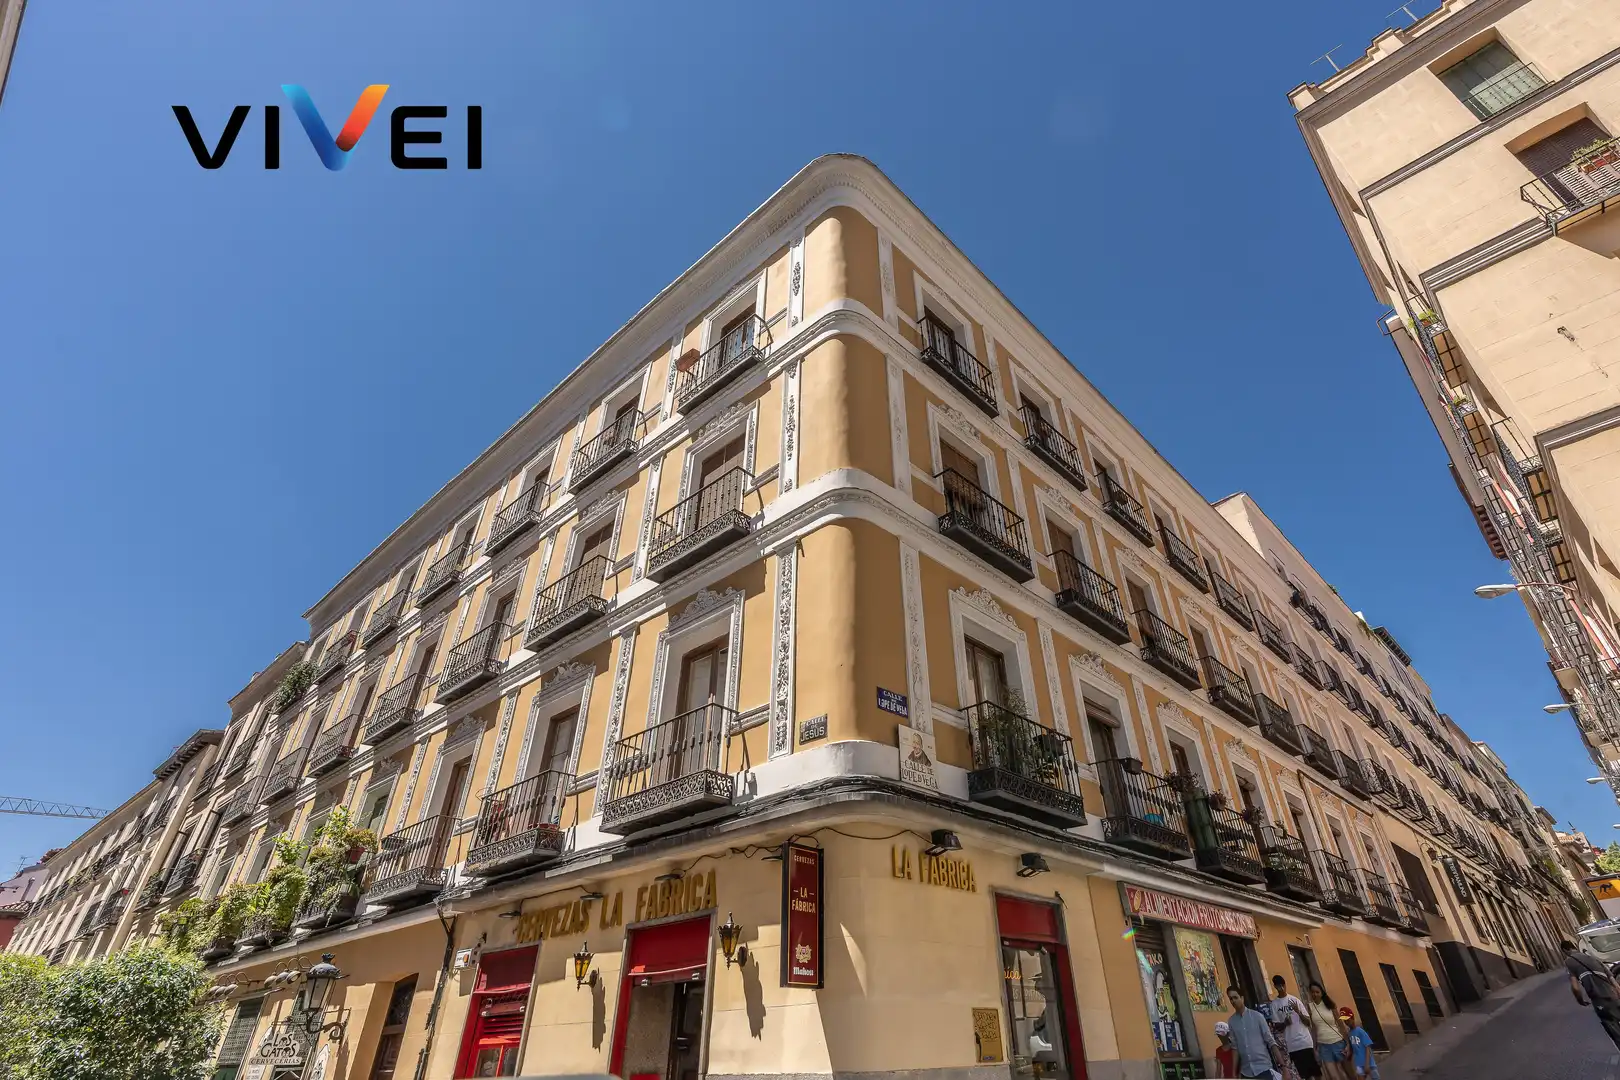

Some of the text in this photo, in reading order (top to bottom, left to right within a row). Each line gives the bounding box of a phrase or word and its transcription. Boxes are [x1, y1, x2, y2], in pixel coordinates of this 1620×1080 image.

[883, 690, 903, 702] CALLE
[896, 704, 908, 716] VEGA
[806, 716, 825, 727] CALLE
[904, 759, 926, 774] CALLE
[901, 768, 917, 783] LOPE
[922, 774, 939, 790] VEGA
[793, 854, 815, 865] CERVEZAS
[892, 843, 912, 880] LA
[800, 886, 808, 898] LA
[600, 891, 624, 930] LA
[791, 898, 816, 914] FÁBRICA
[793, 966, 814, 976] Mahou
[273, 1033, 293, 1047] LOS
[260, 1042, 297, 1058] GATOS
